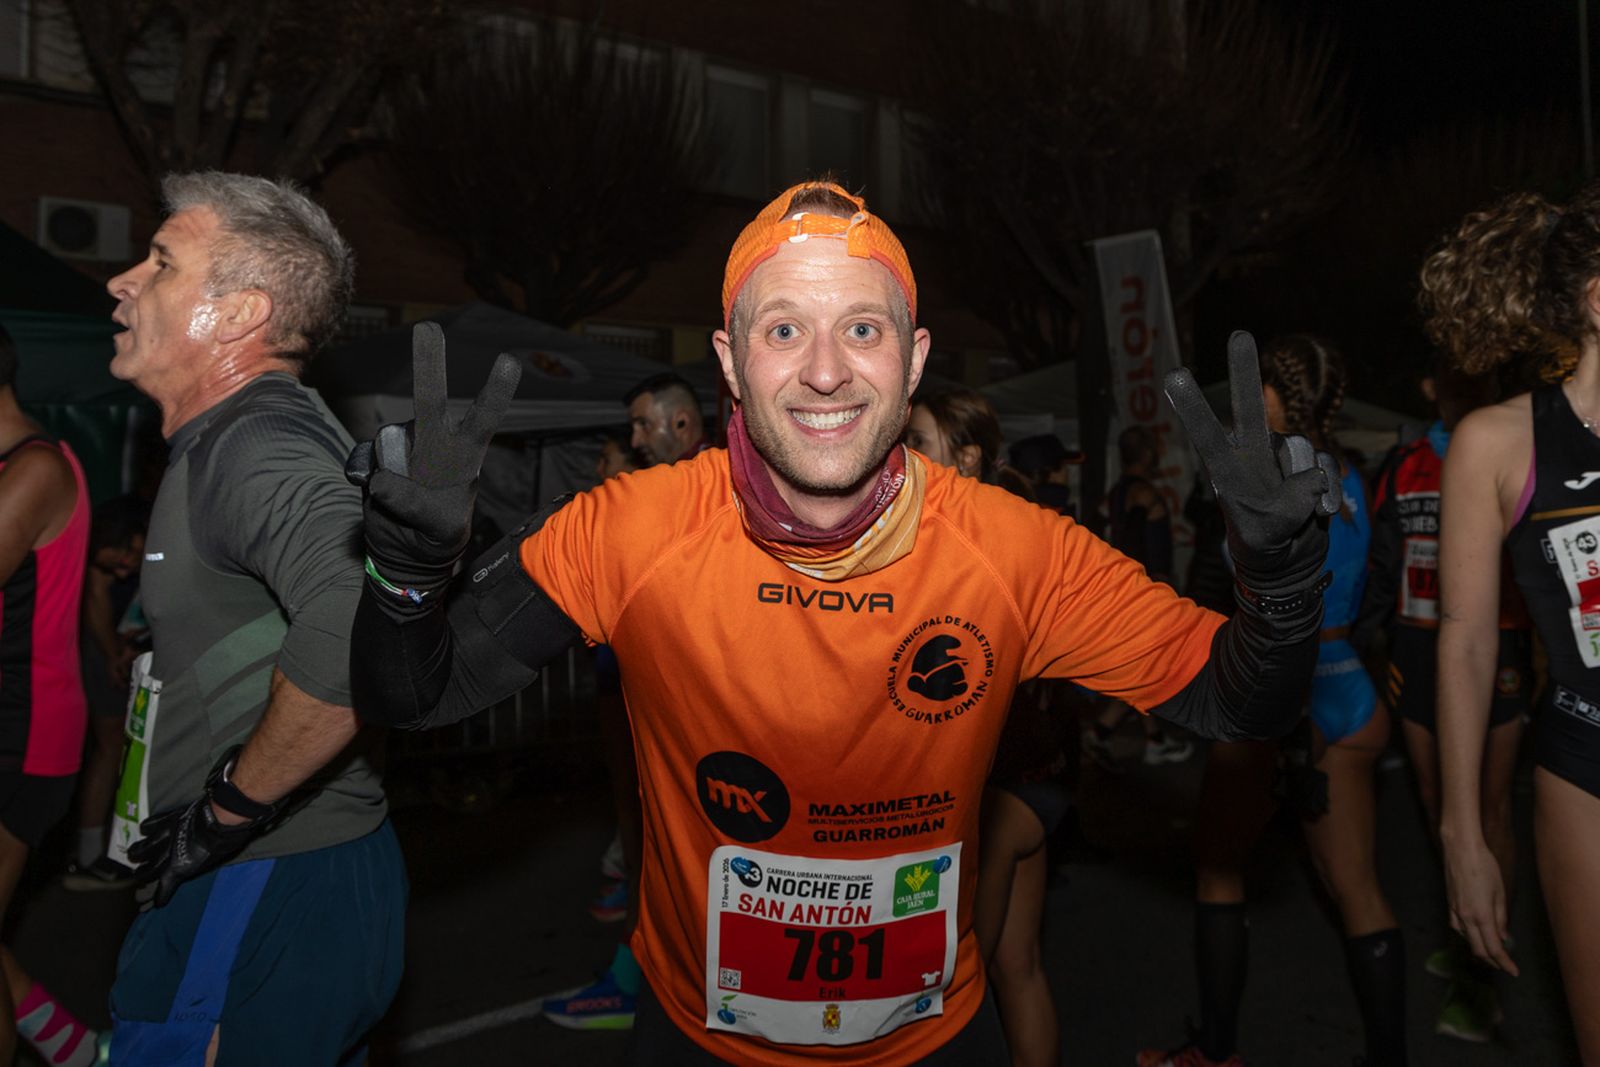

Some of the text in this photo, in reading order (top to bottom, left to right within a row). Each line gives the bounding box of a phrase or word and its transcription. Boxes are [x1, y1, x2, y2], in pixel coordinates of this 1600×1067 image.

[757, 583, 894, 613] GIVOVA
[887, 615, 994, 712] ESCUELA MUNICIPAL DE ATLETISMO
[808, 790, 956, 817] MAXIMETAL
[808, 816, 884, 826] MULTISERVICIOS
[813, 817, 945, 843] GUARROMÁN
[766, 867, 873, 882] CARRERA URBANA INTERNACIONAL
[766, 875, 873, 900] NOCHE DE
[738, 893, 872, 926] SAN ANTÓN
[784, 928, 885, 981] 781
[819, 986, 847, 999] Erik
